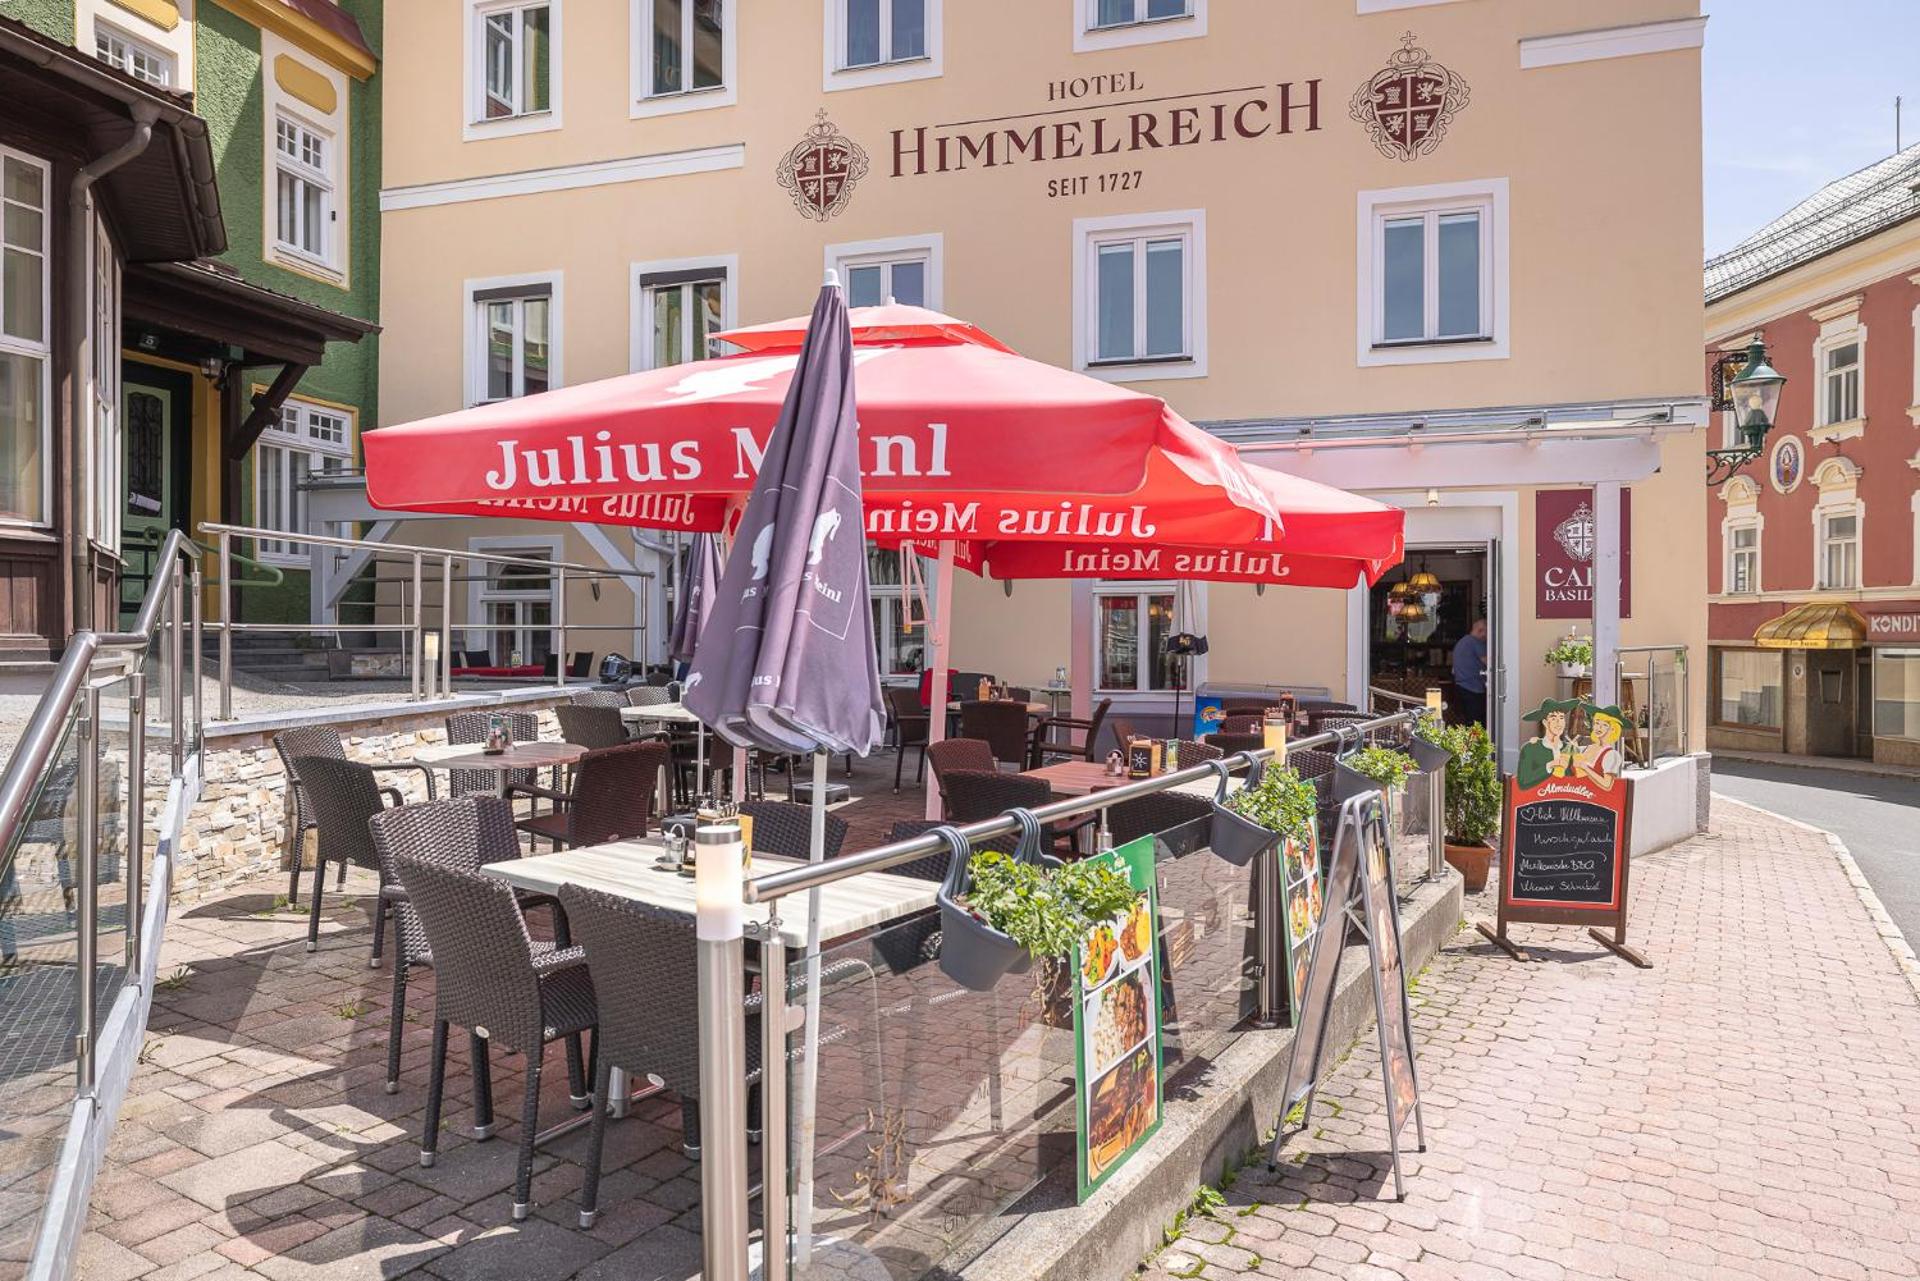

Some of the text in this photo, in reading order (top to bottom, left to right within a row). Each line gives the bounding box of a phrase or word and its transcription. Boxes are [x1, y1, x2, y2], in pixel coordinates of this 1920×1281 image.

[1048, 71, 1144, 101] HOTEL
[889, 78, 1323, 178] HIMMELREICH
[1048, 170, 1143, 198] SEIT 1727
[485, 430, 702, 491] Julius
[815, 574, 842, 603] einl
[1537, 783, 1597, 799] Almdudler
